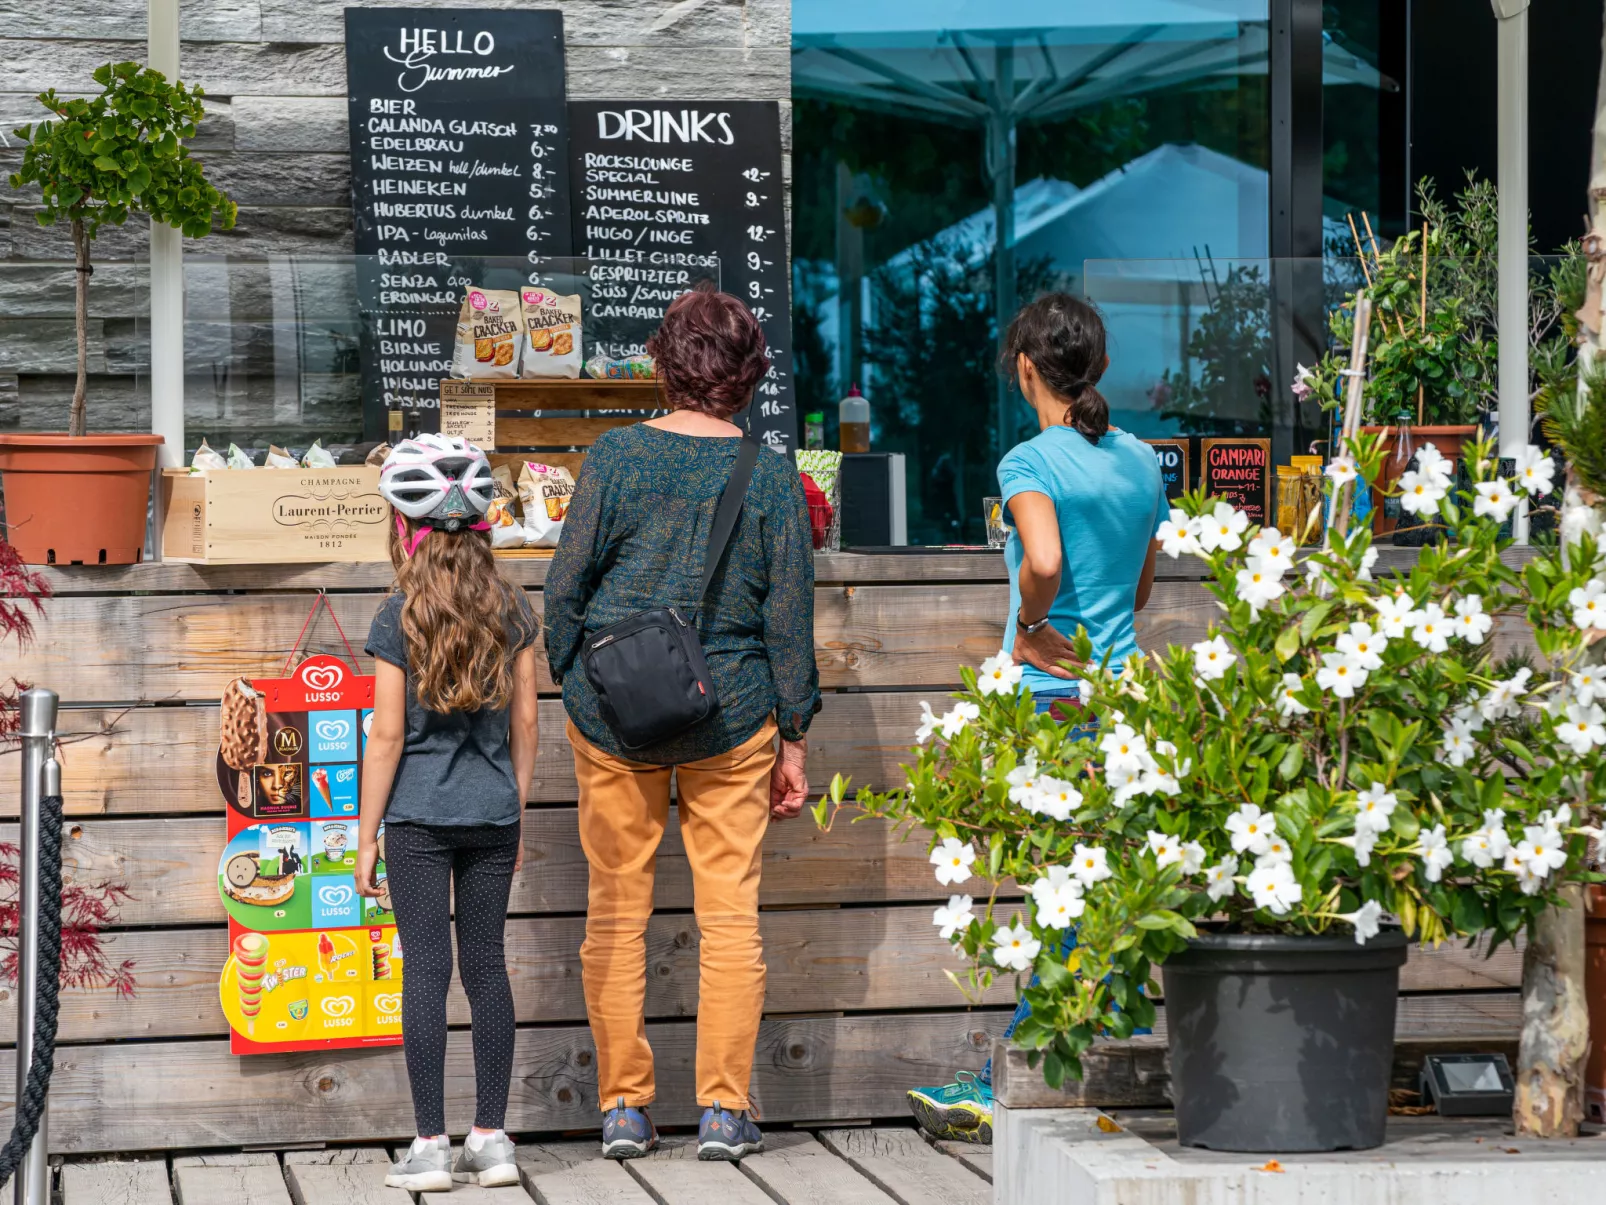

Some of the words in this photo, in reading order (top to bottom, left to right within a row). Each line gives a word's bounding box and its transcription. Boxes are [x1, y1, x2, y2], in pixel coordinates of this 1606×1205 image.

[400, 28, 495, 55] HELLO
[383, 45, 514, 92] Summer
[370, 99, 417, 115] BIER
[368, 118, 445, 134] CALANDA
[450, 120, 517, 137] GLATSCH
[597, 109, 735, 145] DRINKS
[371, 154, 442, 173] WEIZEN
[586, 169, 659, 184] SPECIAL
[372, 179, 466, 196] HEINEKEN
[374, 202, 456, 219] HUBERTUS
[461, 205, 516, 220] dunkel
[377, 225, 410, 242] IPA
[378, 248, 451, 266] RADLER
[588, 245, 646, 262] LILLET
[380, 273, 438, 288] SENZA
[590, 265, 691, 284] GESPRITZTER
[380, 291, 457, 304] ERDINGER
[592, 283, 627, 298] SÜSS
[377, 319, 426, 338] LIMO
[527, 313, 574, 329] CRACKER
[474, 321, 518, 338] CRACKER
[380, 340, 441, 355] BIRNE
[380, 359, 453, 373] HOLUNDE
[382, 376, 445, 390] INGWE
[1210, 448, 1265, 467] CAMPARI
[300, 478, 361, 486] CHAMPAGNE
[1211, 468, 1260, 480] ORANGE
[279, 503, 383, 517] Laurent-Perrier
[319, 540, 342, 548] 1812
[305, 692, 340, 702] LUSSO
[318, 742, 348, 751] LUSSO
[321, 907, 350, 916] LUSSO
[324, 1018, 352, 1027] LUSSO
